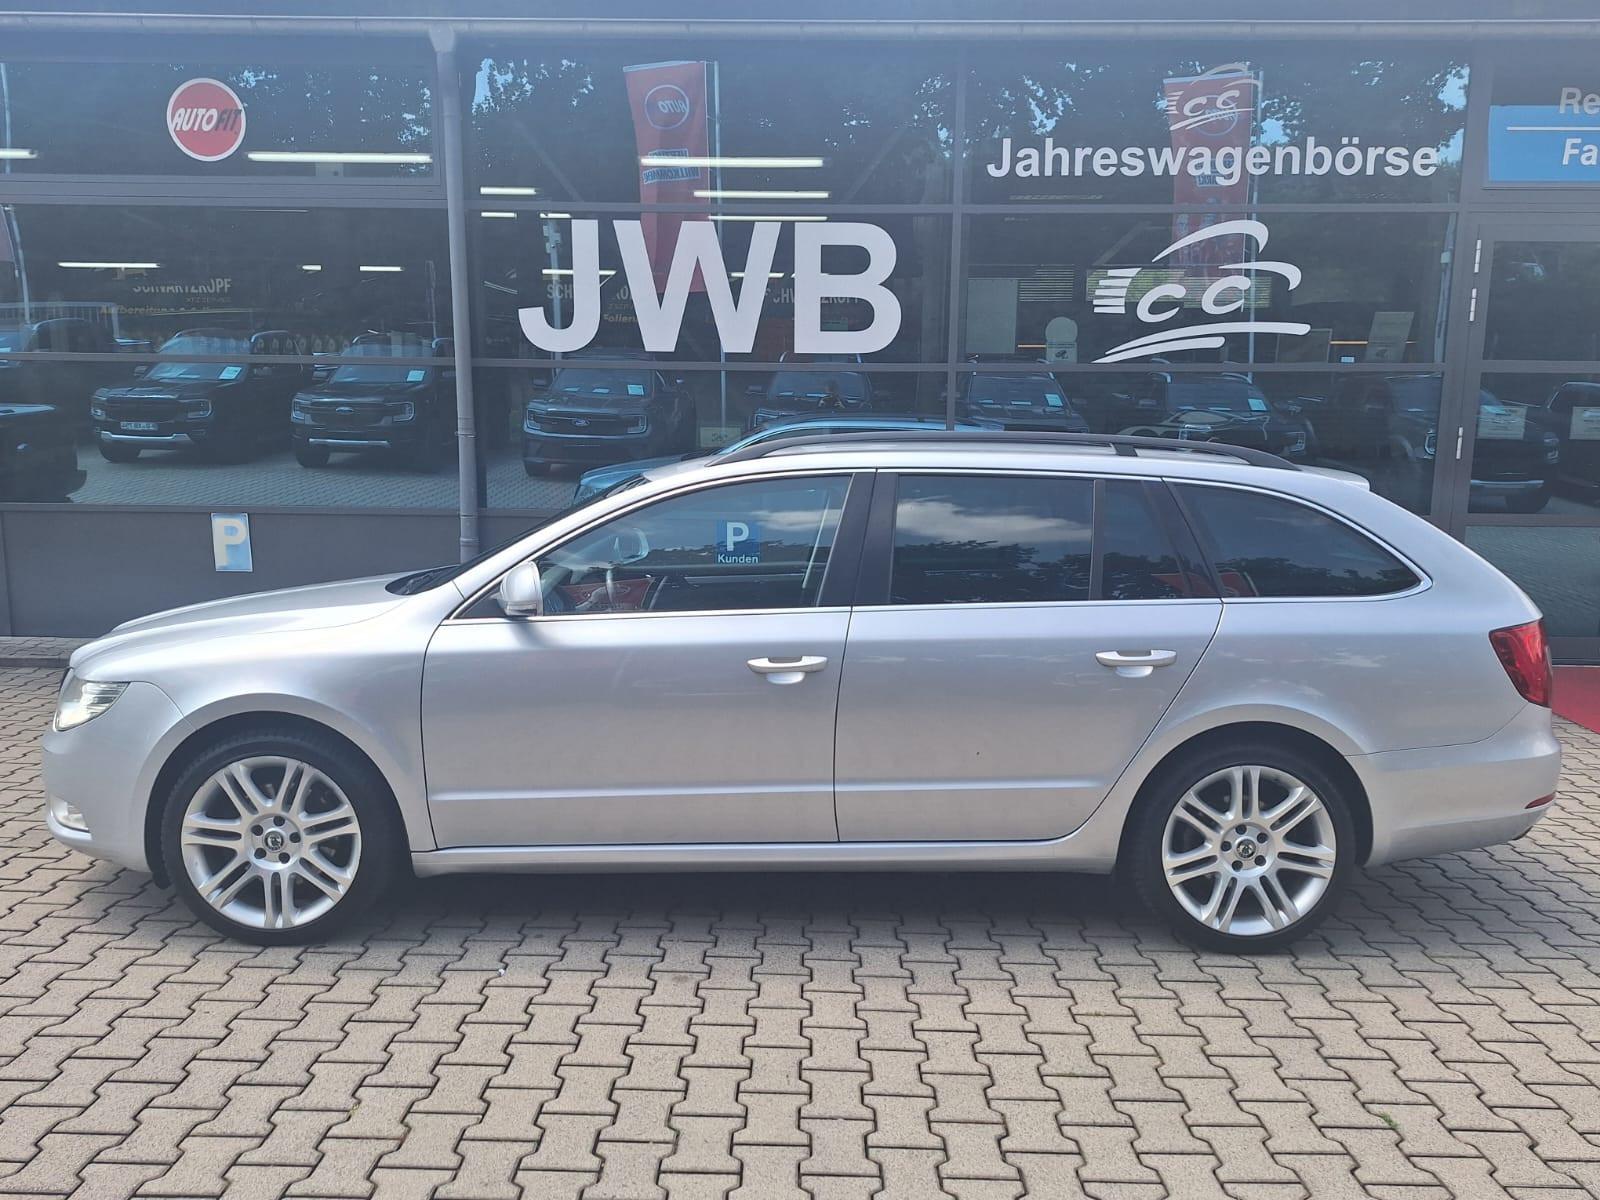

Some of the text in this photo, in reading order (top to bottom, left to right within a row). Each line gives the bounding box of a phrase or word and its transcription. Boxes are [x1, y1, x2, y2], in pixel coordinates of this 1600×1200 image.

[173, 107, 242, 132] AUTOFIT
[986, 136, 1438, 185] Jahreswagenbörse
[518, 219, 901, 353] JWB
[213, 518, 247, 566] P
[726, 521, 750, 552] P
[717, 554, 759, 564] Kunden
